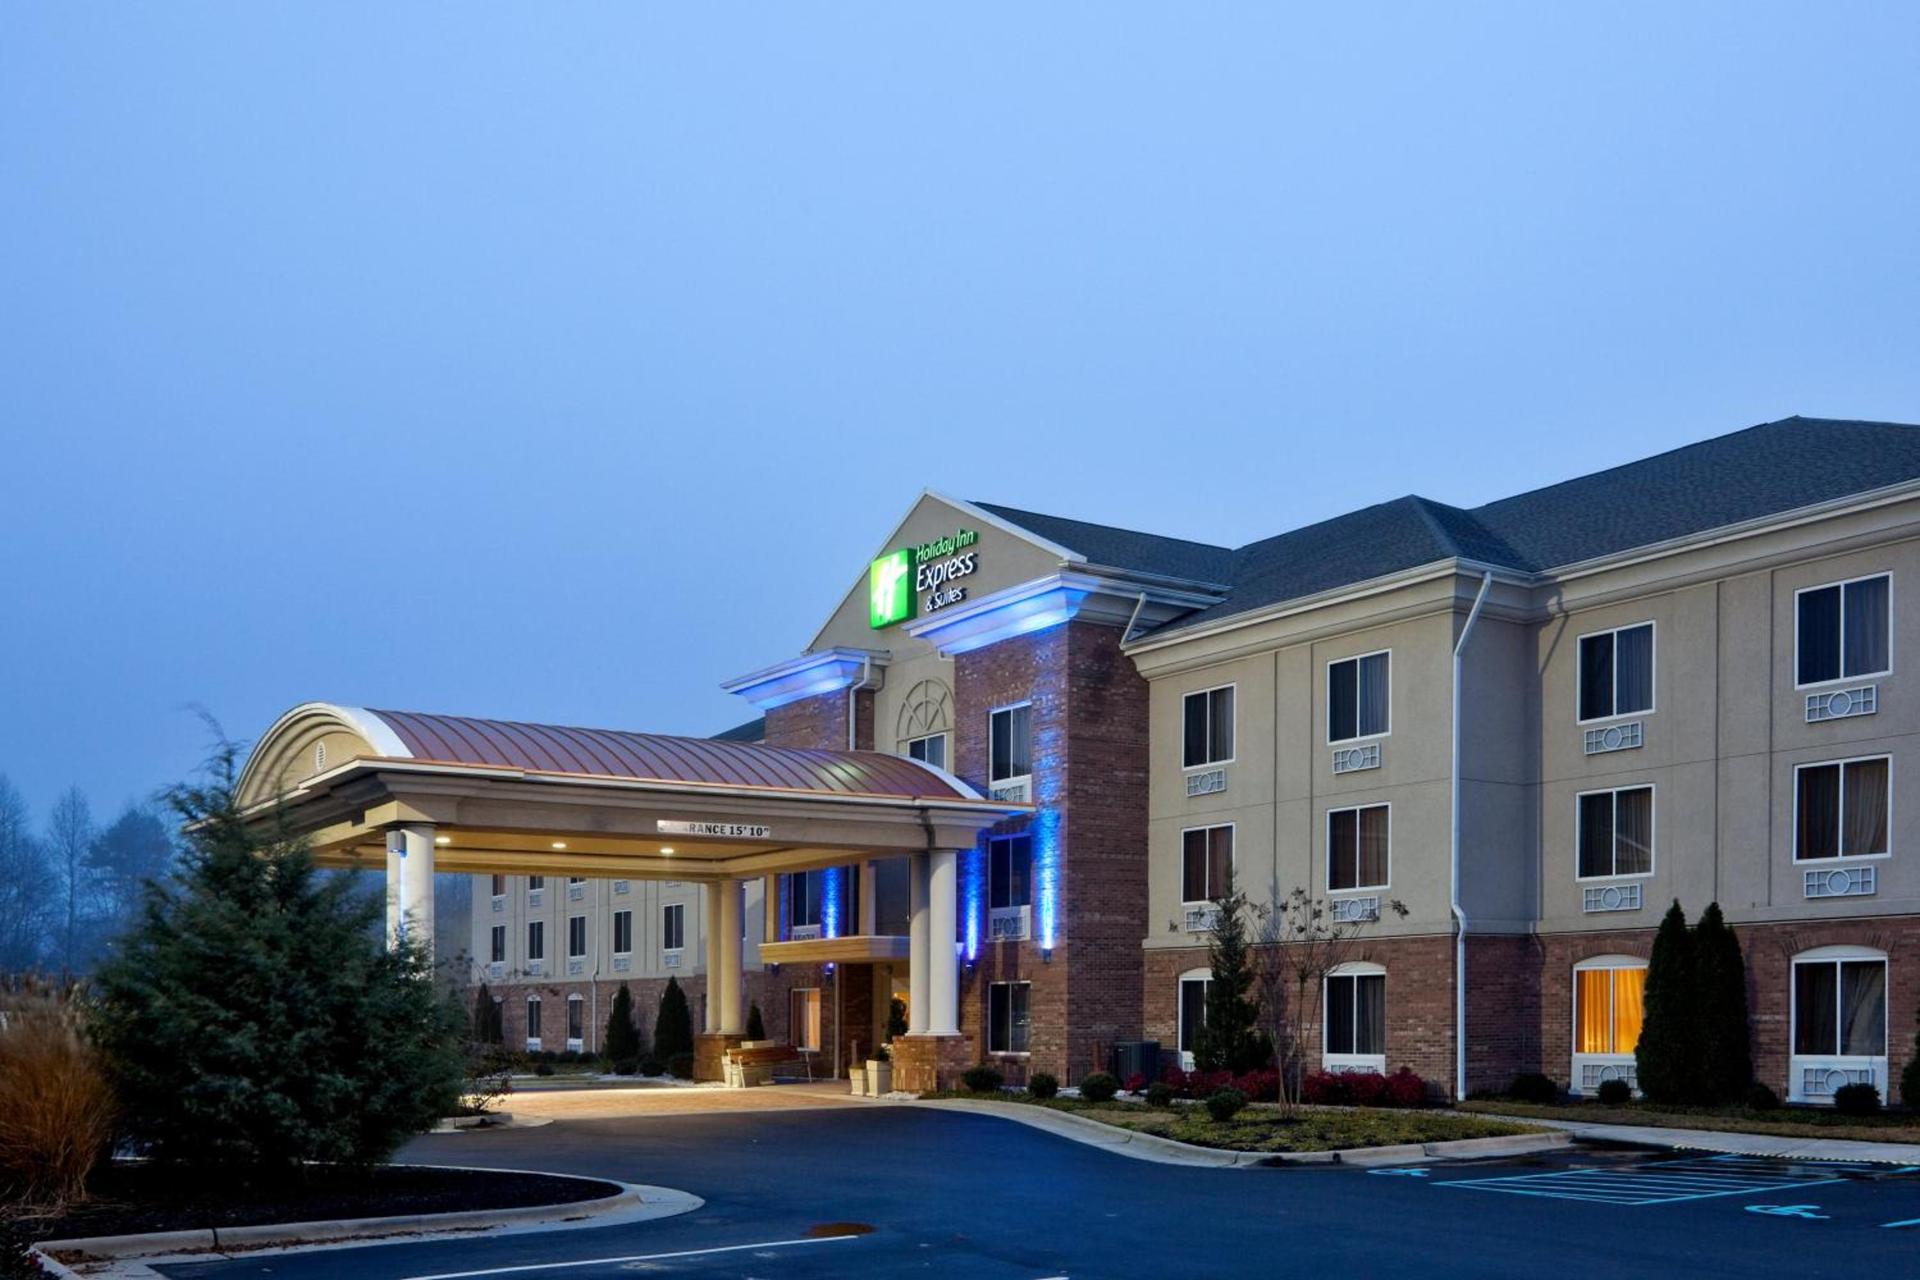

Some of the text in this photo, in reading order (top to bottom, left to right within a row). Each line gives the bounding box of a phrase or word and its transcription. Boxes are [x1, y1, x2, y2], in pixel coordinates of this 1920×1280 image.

[916, 529, 974, 562] Holiday Inn
[916, 552, 974, 592] Express
[925, 587, 963, 612] & Suites
